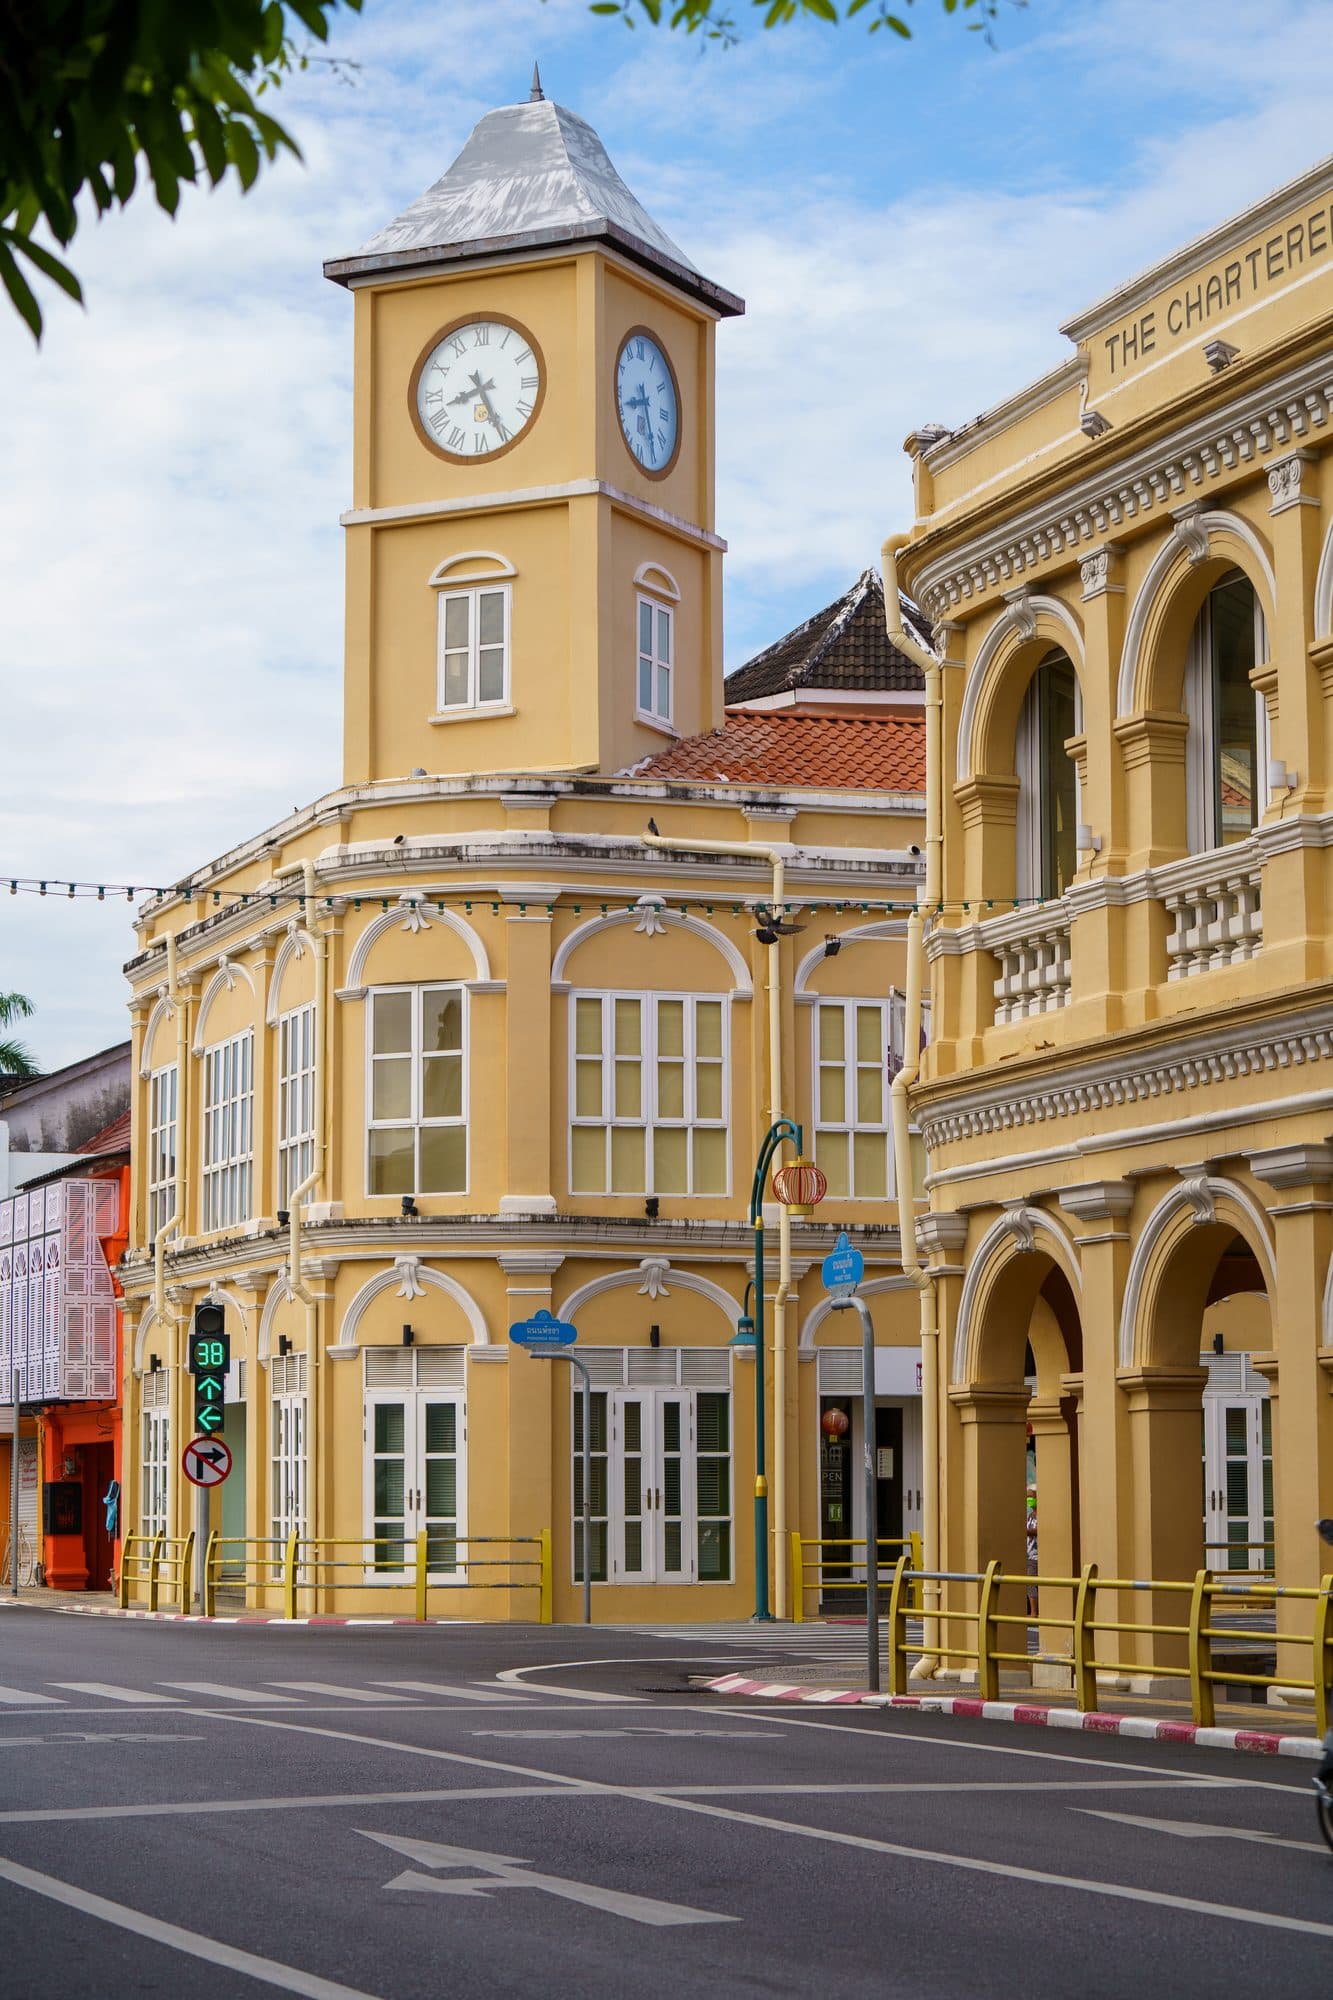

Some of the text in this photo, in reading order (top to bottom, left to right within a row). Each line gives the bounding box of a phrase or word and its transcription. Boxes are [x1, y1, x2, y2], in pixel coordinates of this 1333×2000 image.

[1104, 204, 1333, 374] THE CHARTERE
[448, 335, 468, 359] XI
[473, 326, 490, 347] XII
[499, 329, 513, 350] I
[513, 349, 532, 366] II
[636, 339, 646, 362] XII
[431, 360, 451, 378] X
[520, 376, 538, 390] III
[425, 387, 443, 404] IX
[516, 400, 533, 420] IV
[429, 408, 448, 437] VIII
[447, 426, 467, 451] VII
[474, 432, 490, 453] VI
[197, 1341, 224, 1366] 38
[821, 1471, 843, 1482] PEN
